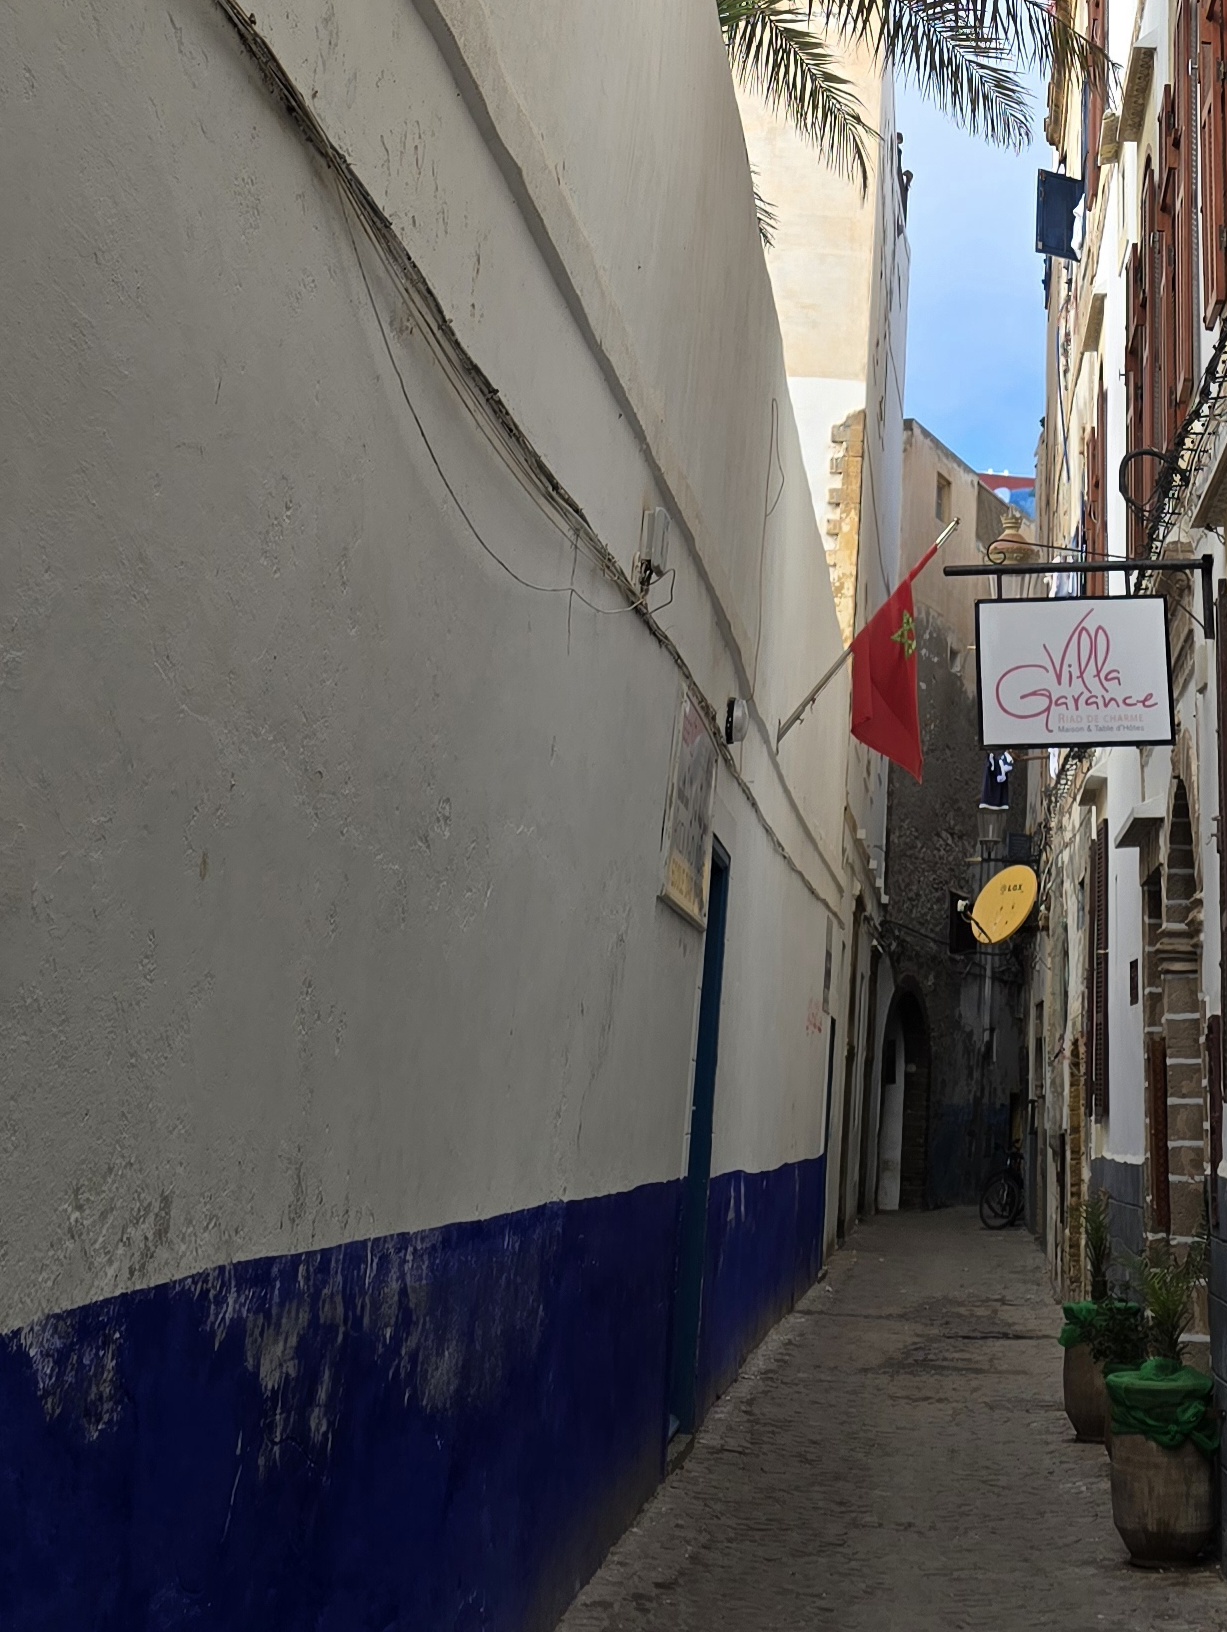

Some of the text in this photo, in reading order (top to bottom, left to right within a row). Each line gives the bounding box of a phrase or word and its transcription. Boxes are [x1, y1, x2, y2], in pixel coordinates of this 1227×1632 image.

[1043, 608, 1121, 693] Villa
[996, 664, 1158, 733] Garance
[1087, 714, 1099, 723] DE
[1103, 714, 1143, 722] CHARME
